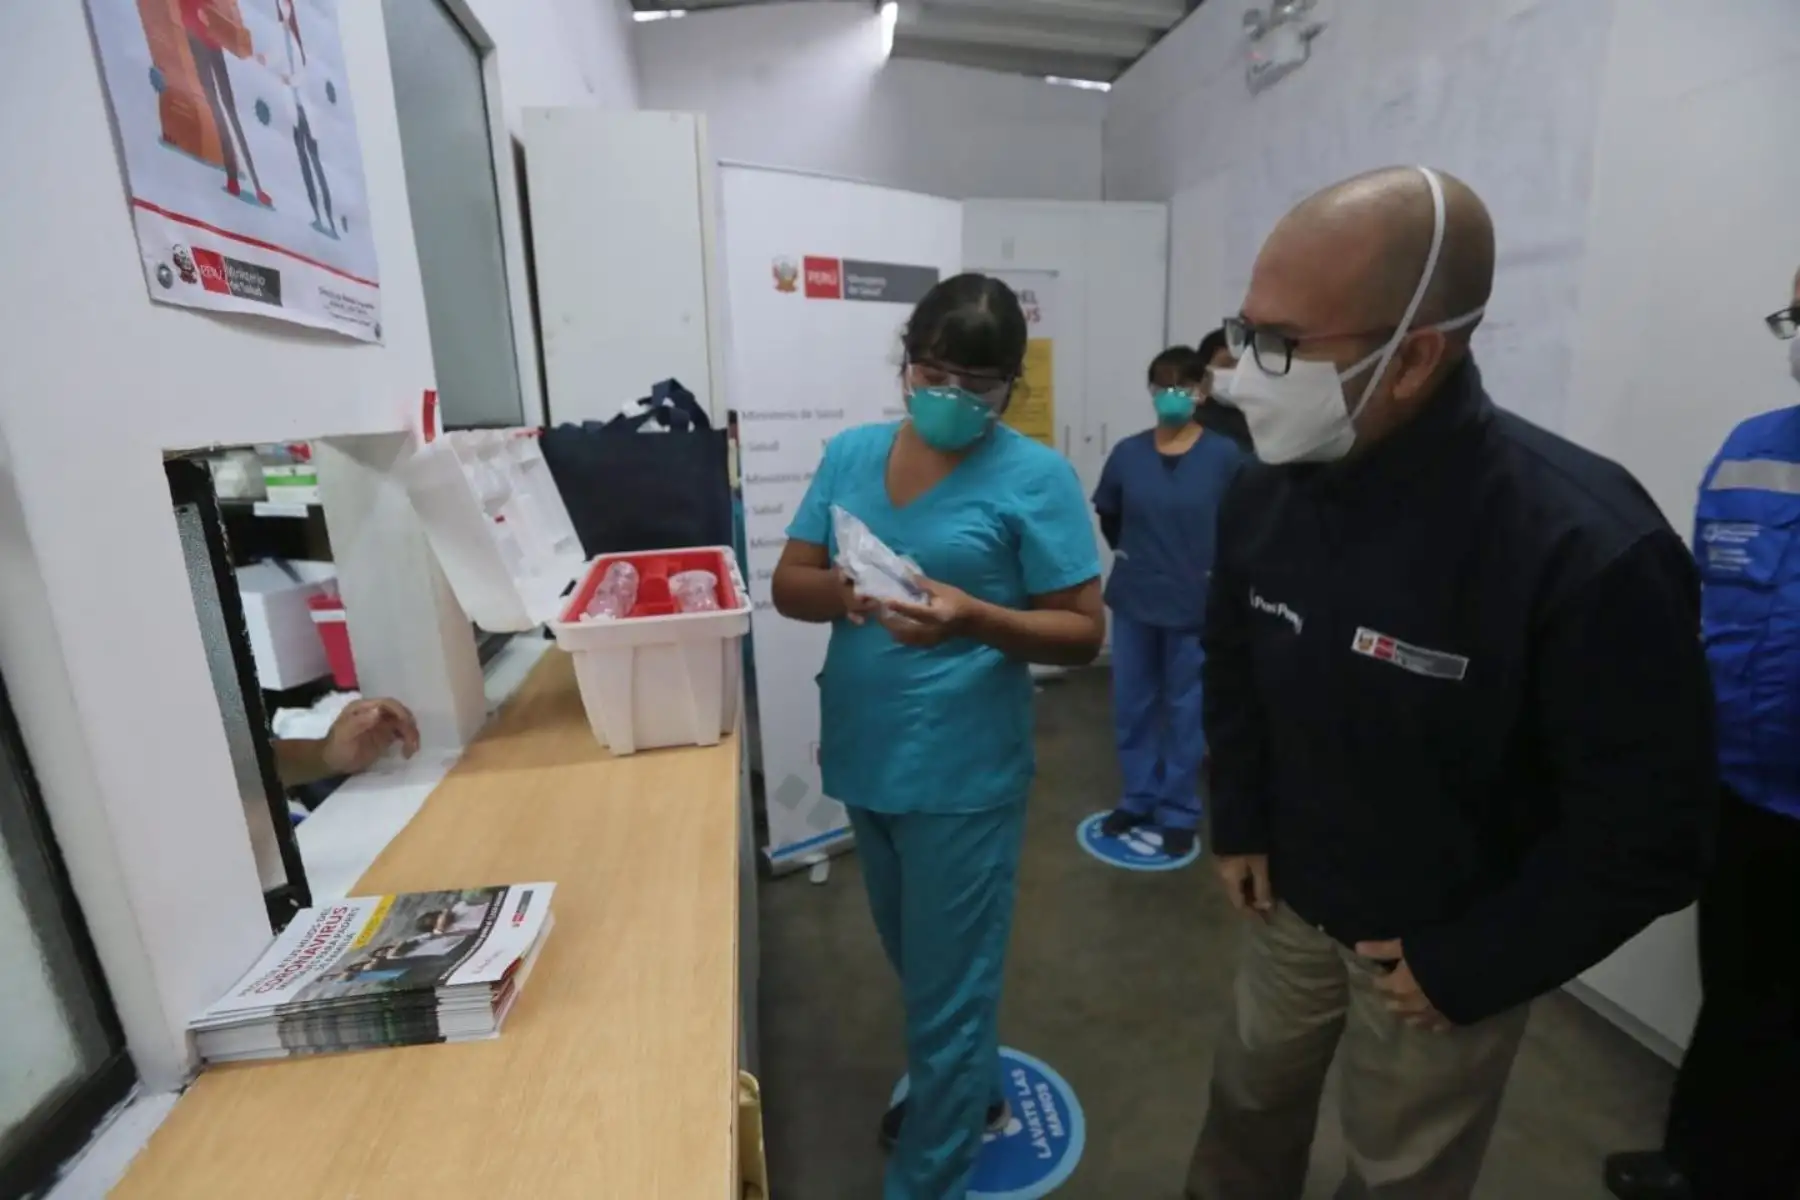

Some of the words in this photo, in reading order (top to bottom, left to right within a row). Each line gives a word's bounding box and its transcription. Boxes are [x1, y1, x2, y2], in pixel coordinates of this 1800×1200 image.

[254, 905, 350, 994] CORONAVIRUS
[1011, 1067, 1032, 1097] LAS
[1035, 1082, 1065, 1138] MANOS
